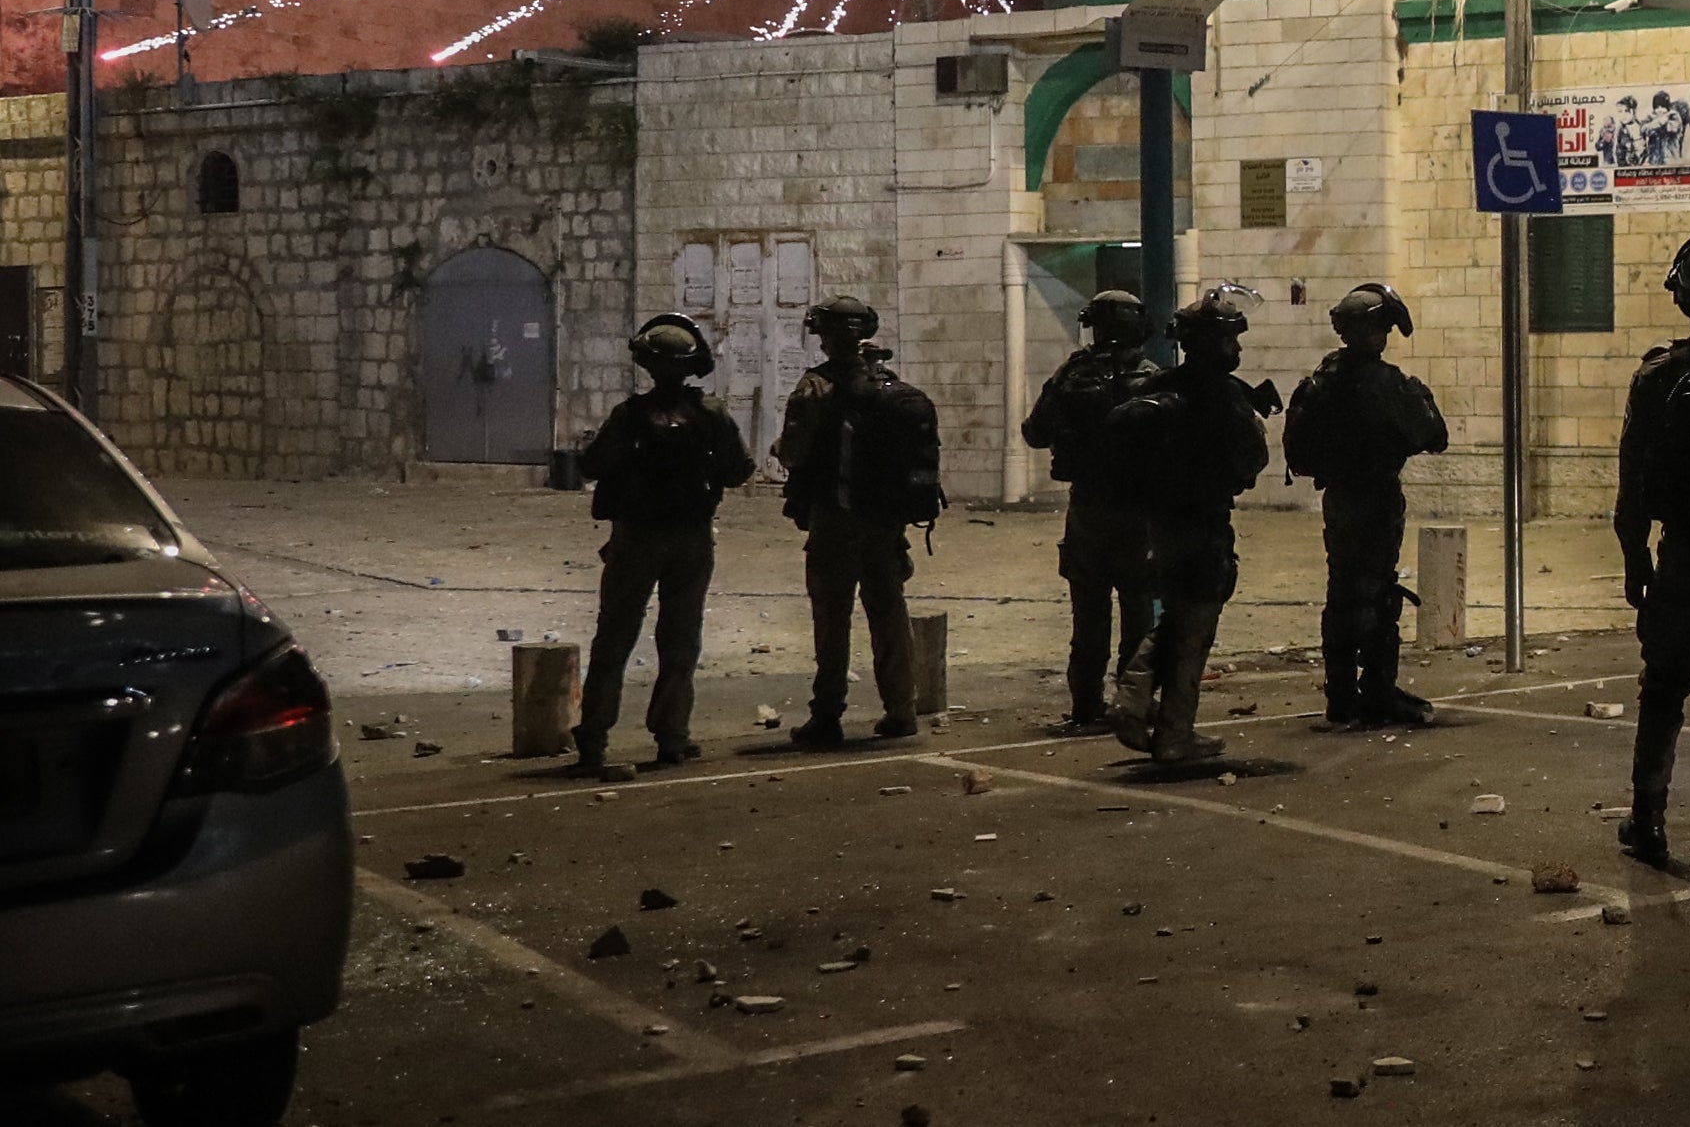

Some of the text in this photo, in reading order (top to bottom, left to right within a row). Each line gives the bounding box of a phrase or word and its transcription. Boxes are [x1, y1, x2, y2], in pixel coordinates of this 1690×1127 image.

[1537, 95, 1570, 108] العيش
[1572, 95, 1606, 105] جمعية
[1558, 132, 1587, 153] الدا
[87, 296, 95, 331] 375
